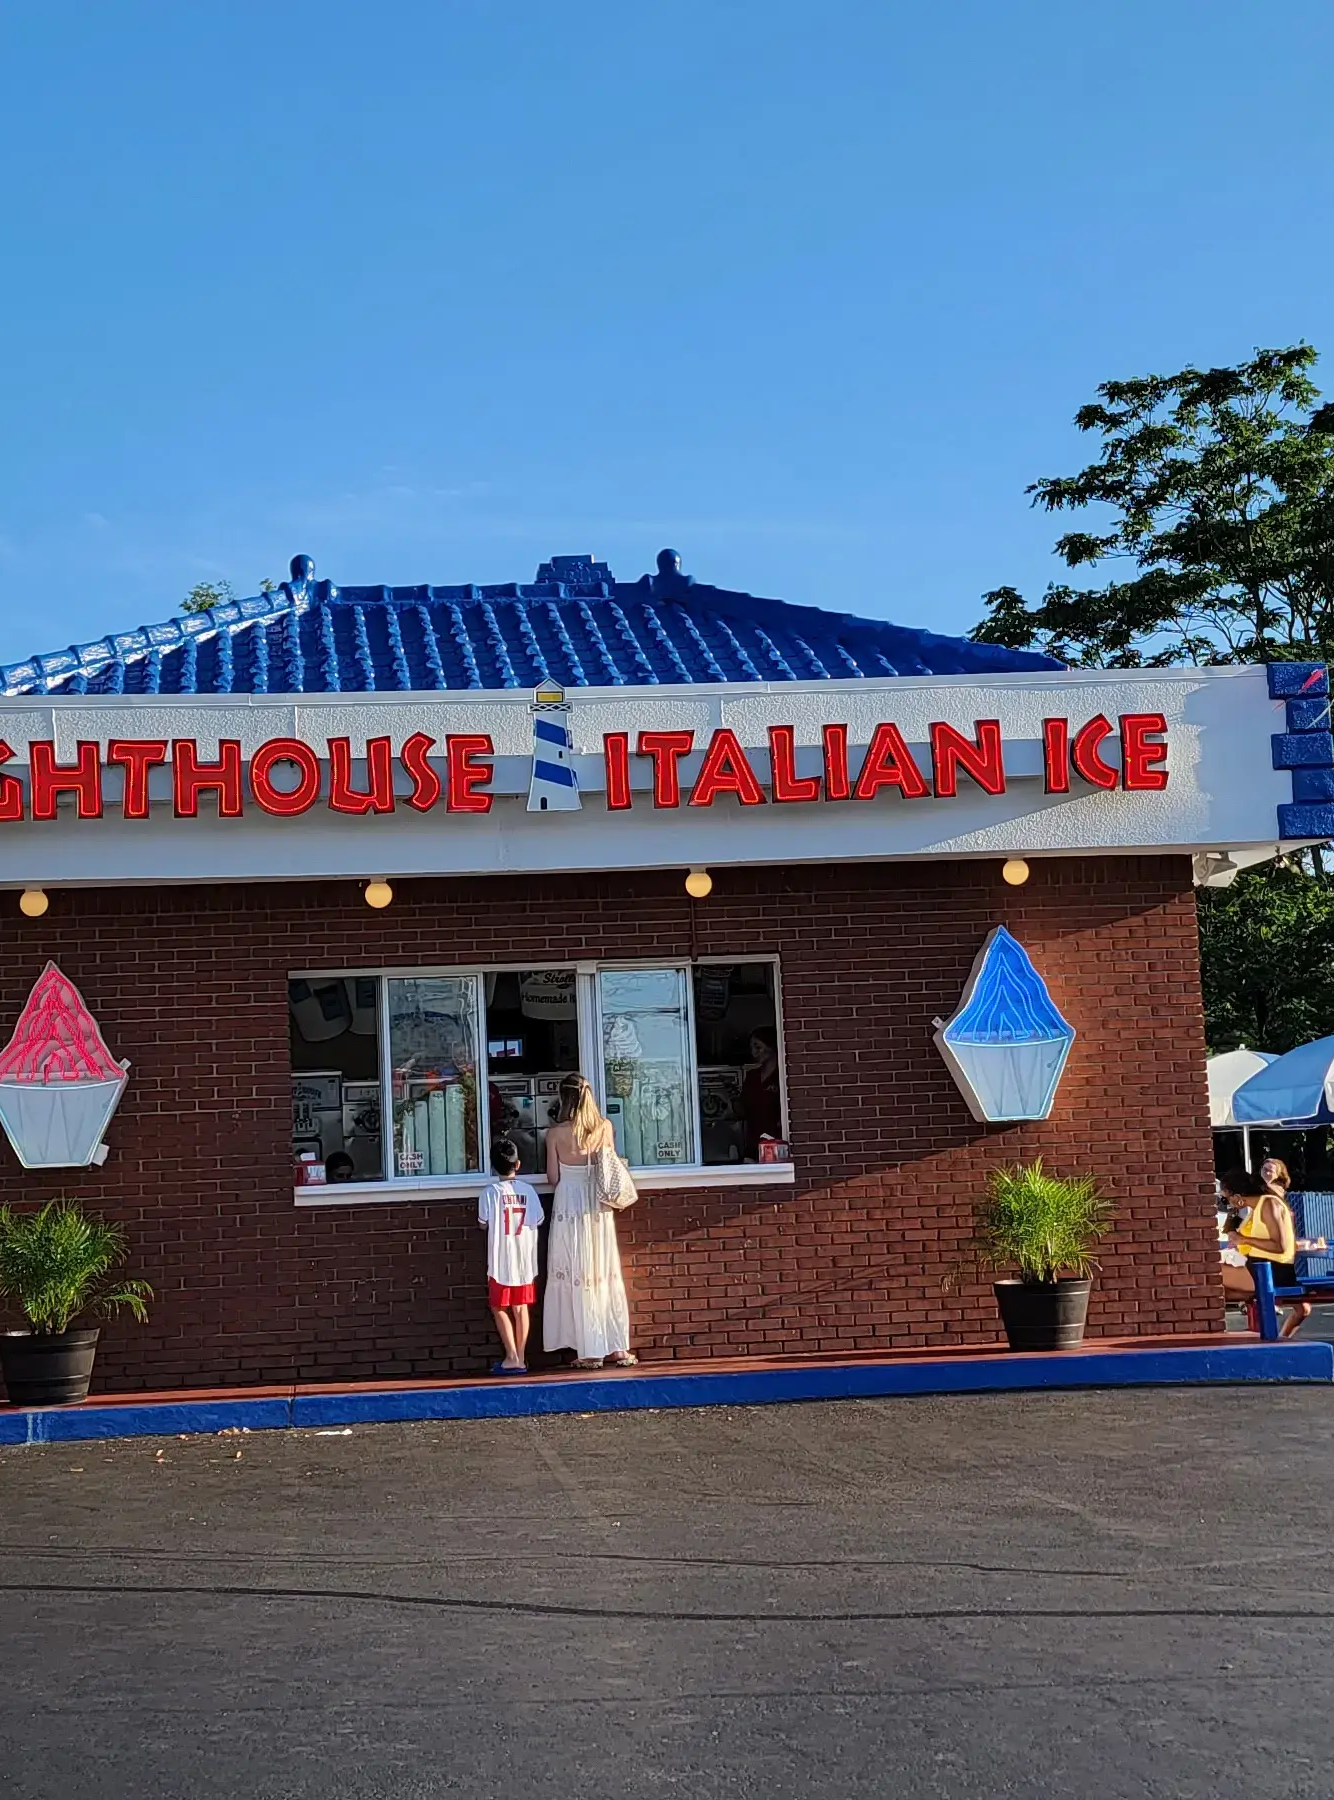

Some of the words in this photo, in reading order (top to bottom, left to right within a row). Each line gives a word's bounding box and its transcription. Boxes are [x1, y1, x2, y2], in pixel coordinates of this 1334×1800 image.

[602, 717, 1007, 811] ITALIAN
[1043, 711, 1169, 794] ICE
[657, 1141, 681, 1149] CASH
[658, 1150, 680, 1158] ONLY
[400, 1161, 423, 1169] ONLY
[503, 1207, 526, 1236] 17
